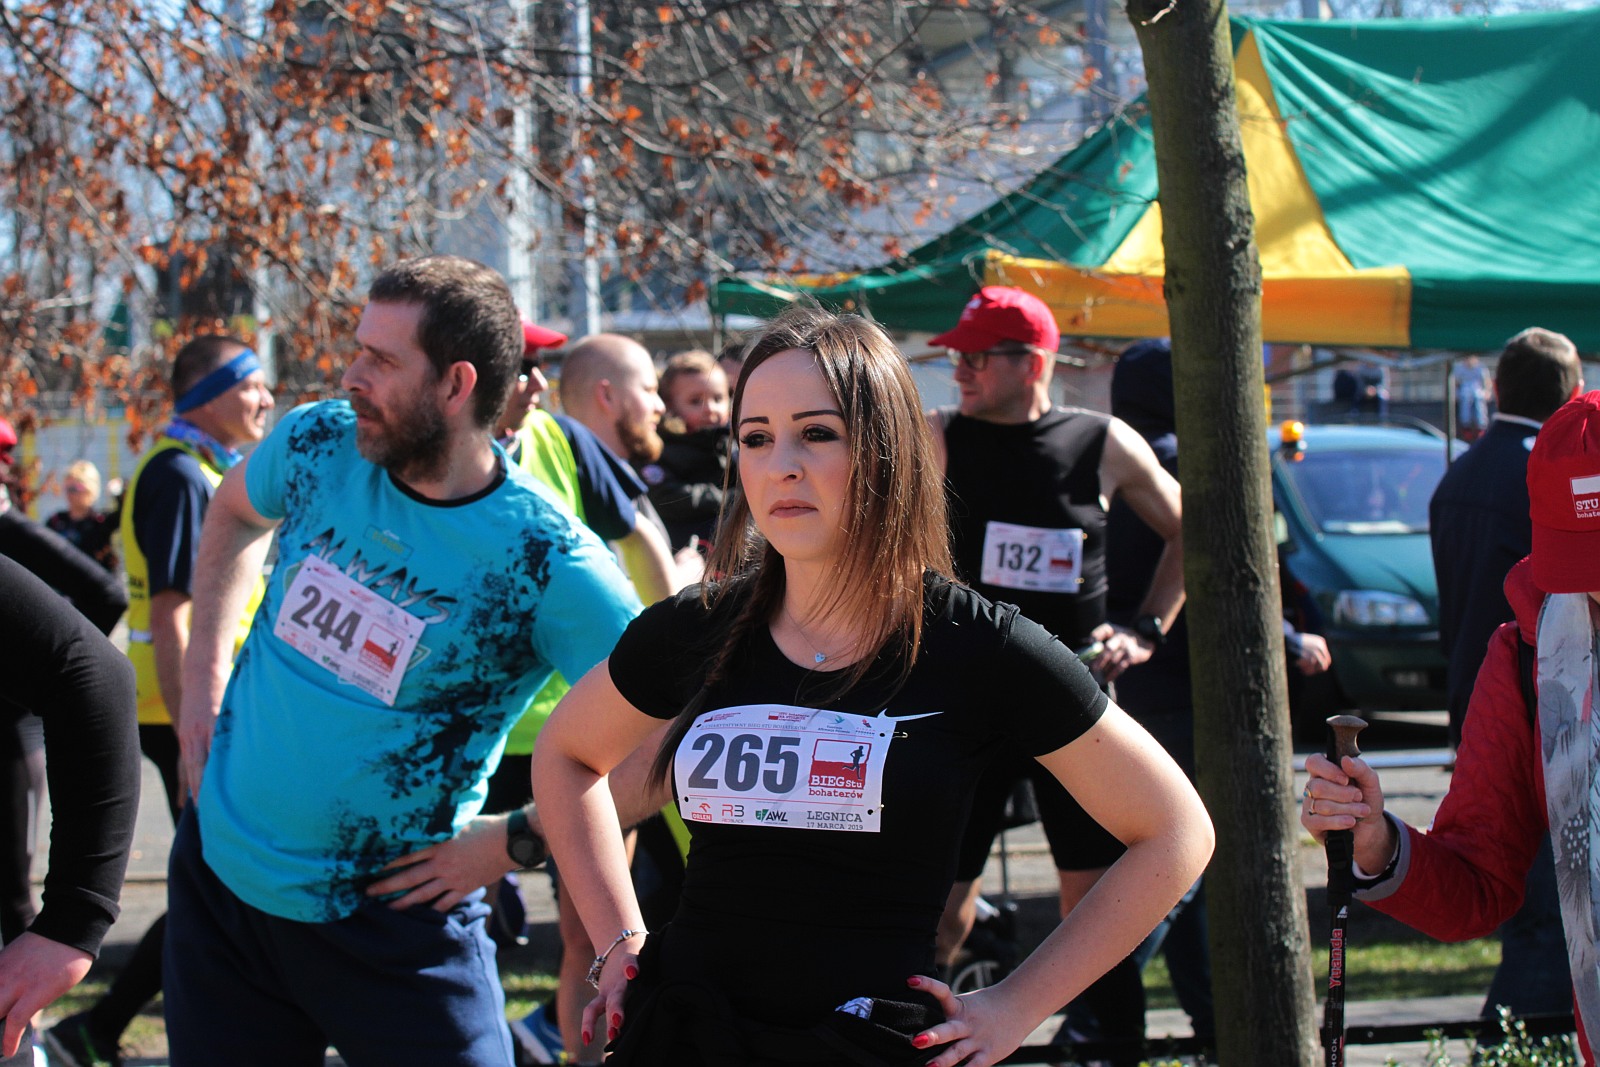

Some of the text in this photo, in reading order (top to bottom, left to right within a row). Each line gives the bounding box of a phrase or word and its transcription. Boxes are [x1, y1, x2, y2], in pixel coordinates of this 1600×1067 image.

[1575, 498, 1599, 511] STU
[995, 542, 1043, 573] 132
[301, 526, 458, 625] ALWAYS
[290, 584, 362, 654] 244
[687, 733, 801, 794] 265
[810, 775, 862, 788] BIEG stu
[808, 788, 863, 799] bohaterów
[691, 813, 712, 821] ORLEN
[806, 810, 863, 823] LEGNICA
[817, 822, 845, 830] MARCA
[1328, 928, 1343, 989] Yuanda
